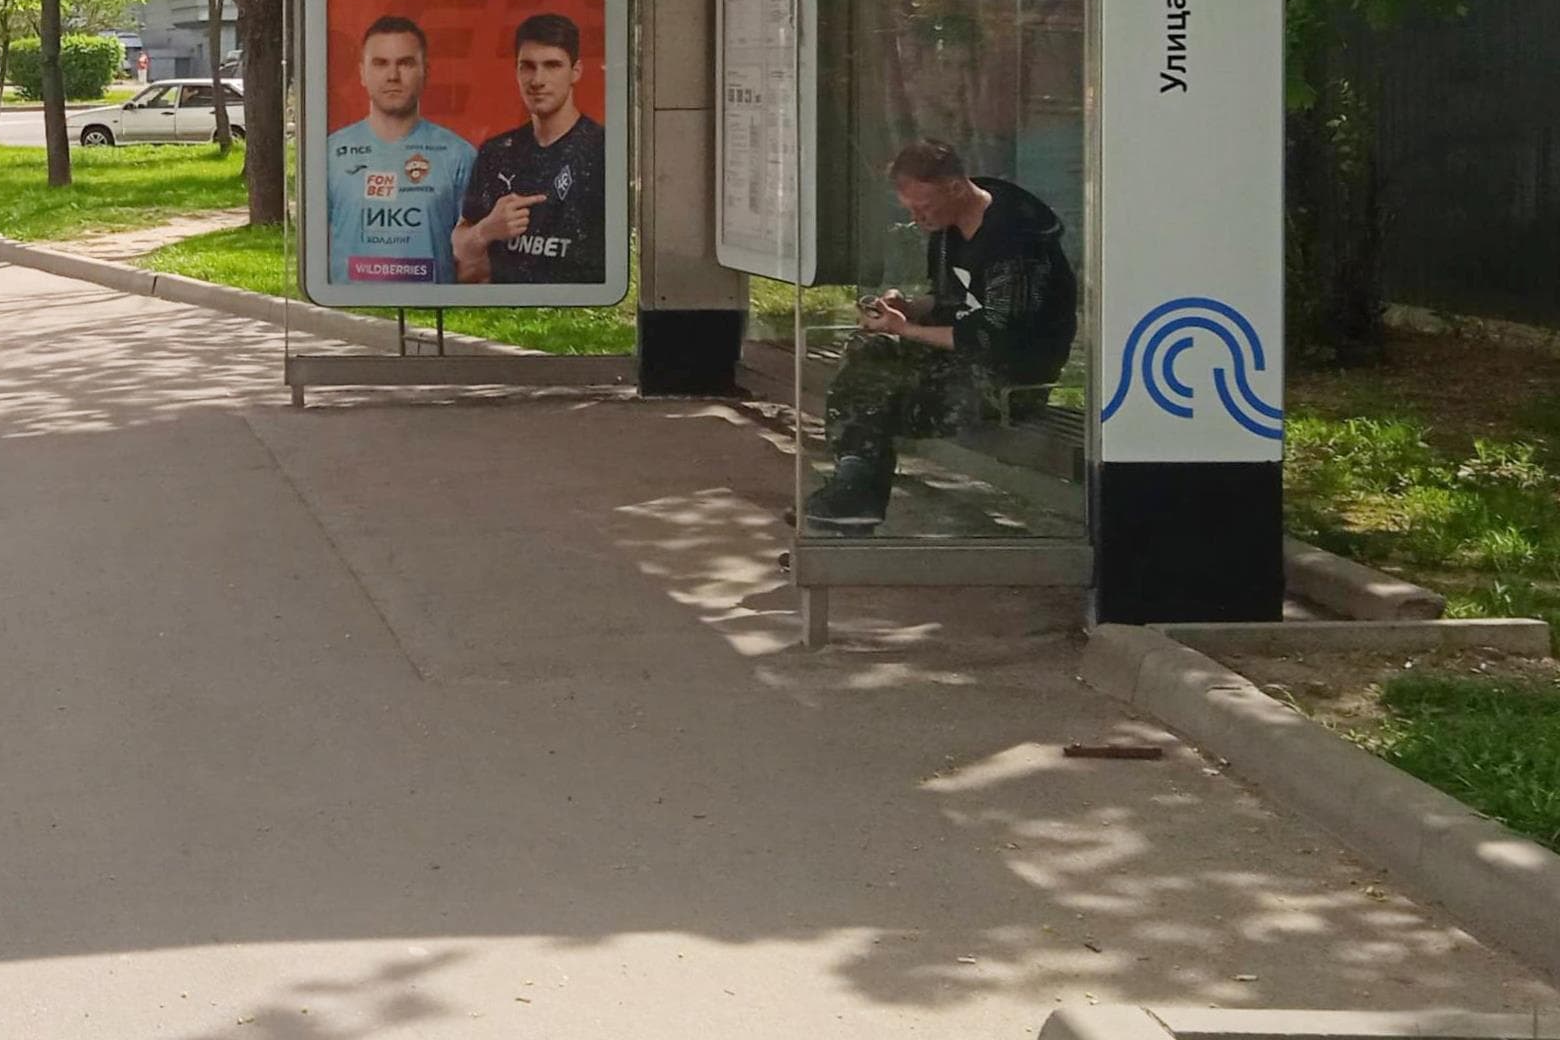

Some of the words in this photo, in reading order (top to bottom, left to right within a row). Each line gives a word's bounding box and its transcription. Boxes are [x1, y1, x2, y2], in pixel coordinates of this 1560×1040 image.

[367, 175, 395, 185] FON
[366, 186, 394, 196] BET
[367, 207, 422, 227] ИКС
[507, 235, 572, 257] ONBET
[355, 263, 428, 276] WILDBERRIES
